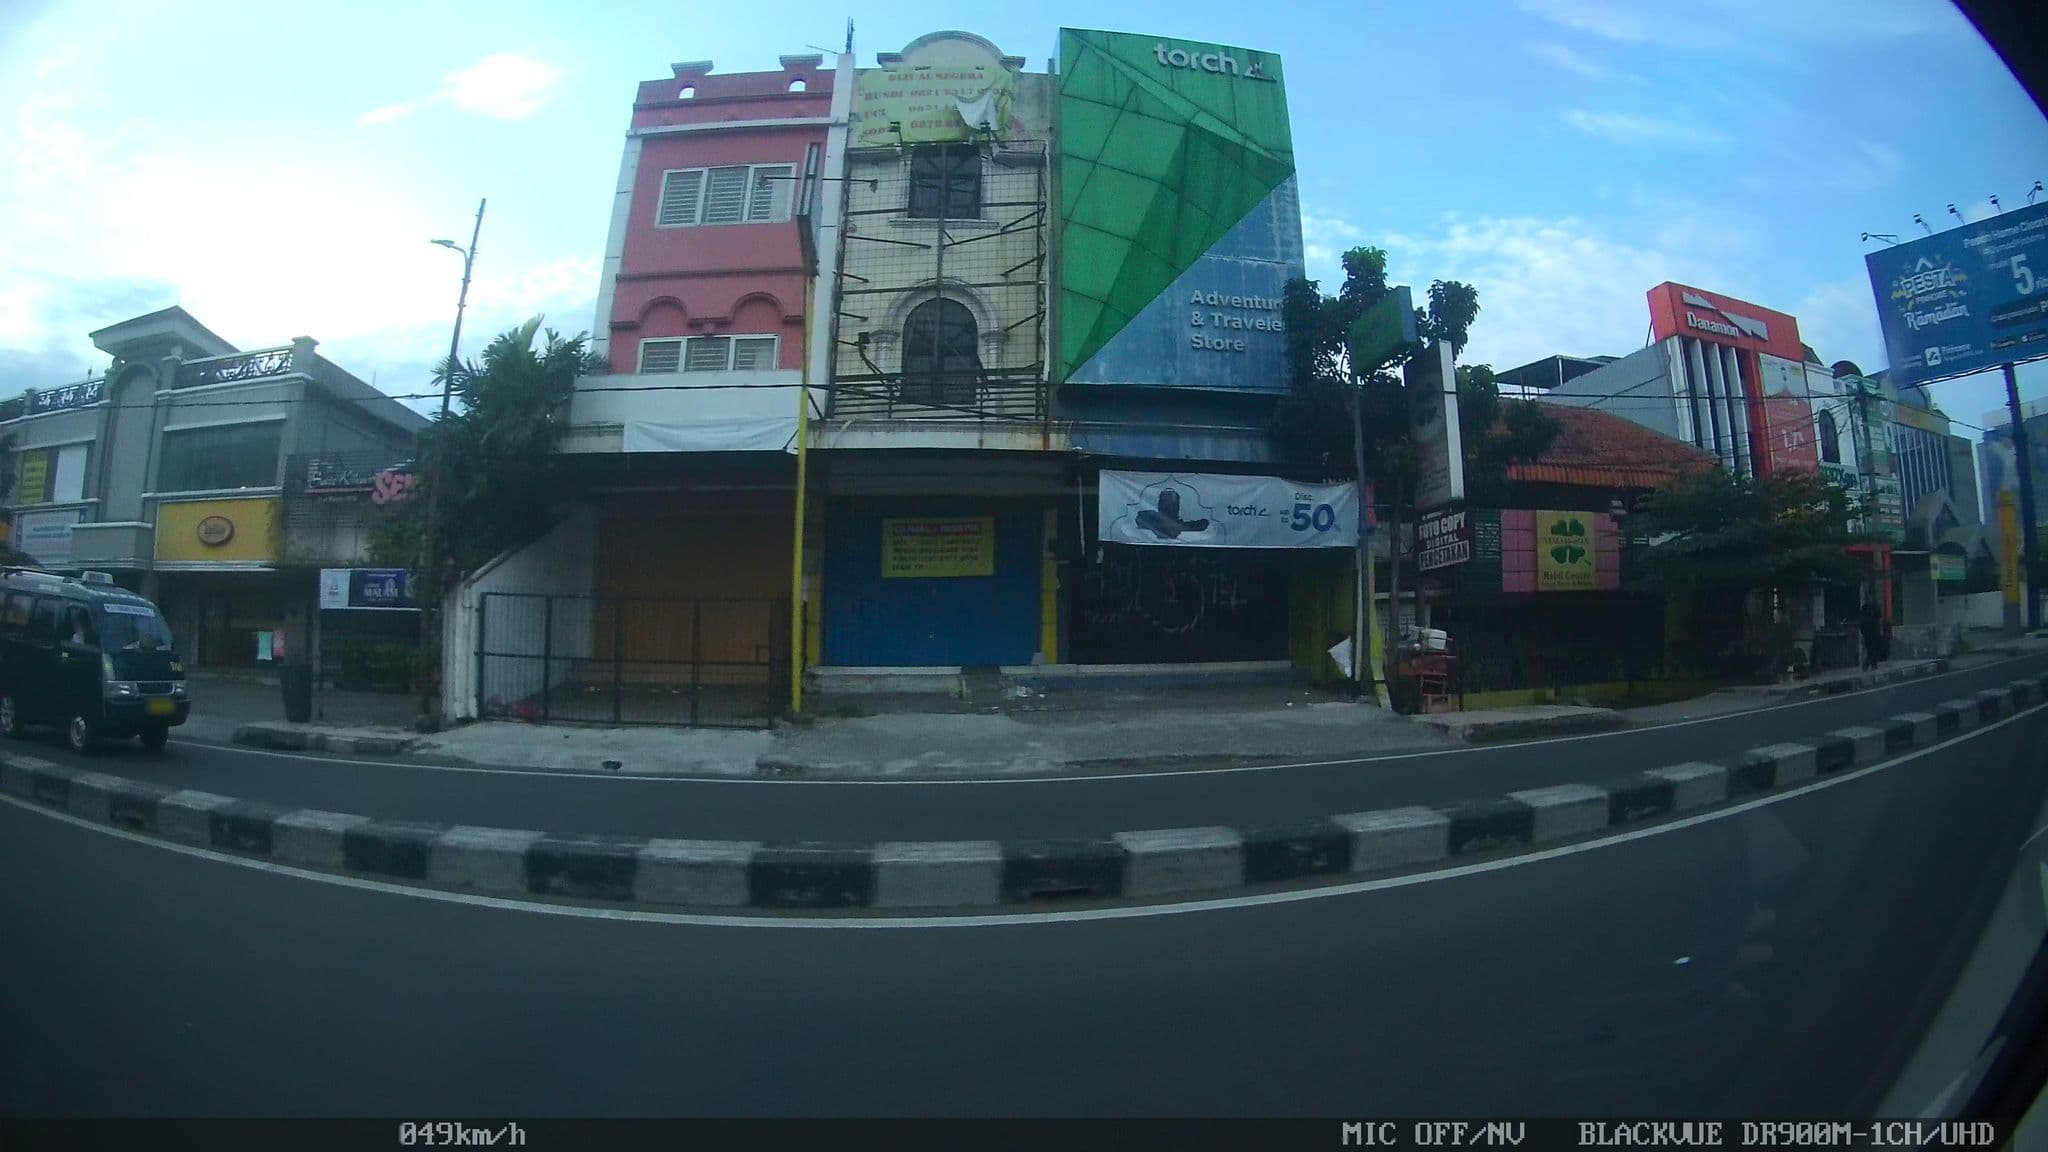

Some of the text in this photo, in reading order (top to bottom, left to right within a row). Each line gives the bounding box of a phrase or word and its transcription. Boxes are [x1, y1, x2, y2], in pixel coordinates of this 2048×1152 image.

[1153, 42, 1240, 76] torch
[1902, 268, 1956, 299] PESTA
[2011, 253, 2035, 294] 5
[1190, 289, 1285, 311] Adventur
[1191, 311, 1205, 327] &
[1686, 311, 1740, 337] Danamon
[1191, 333, 1247, 352] Store
[1227, 503, 1257, 517] torch
[1418, 511, 1466, 541] FOTO COPY
[1426, 532, 1459, 550] DIGITAL
